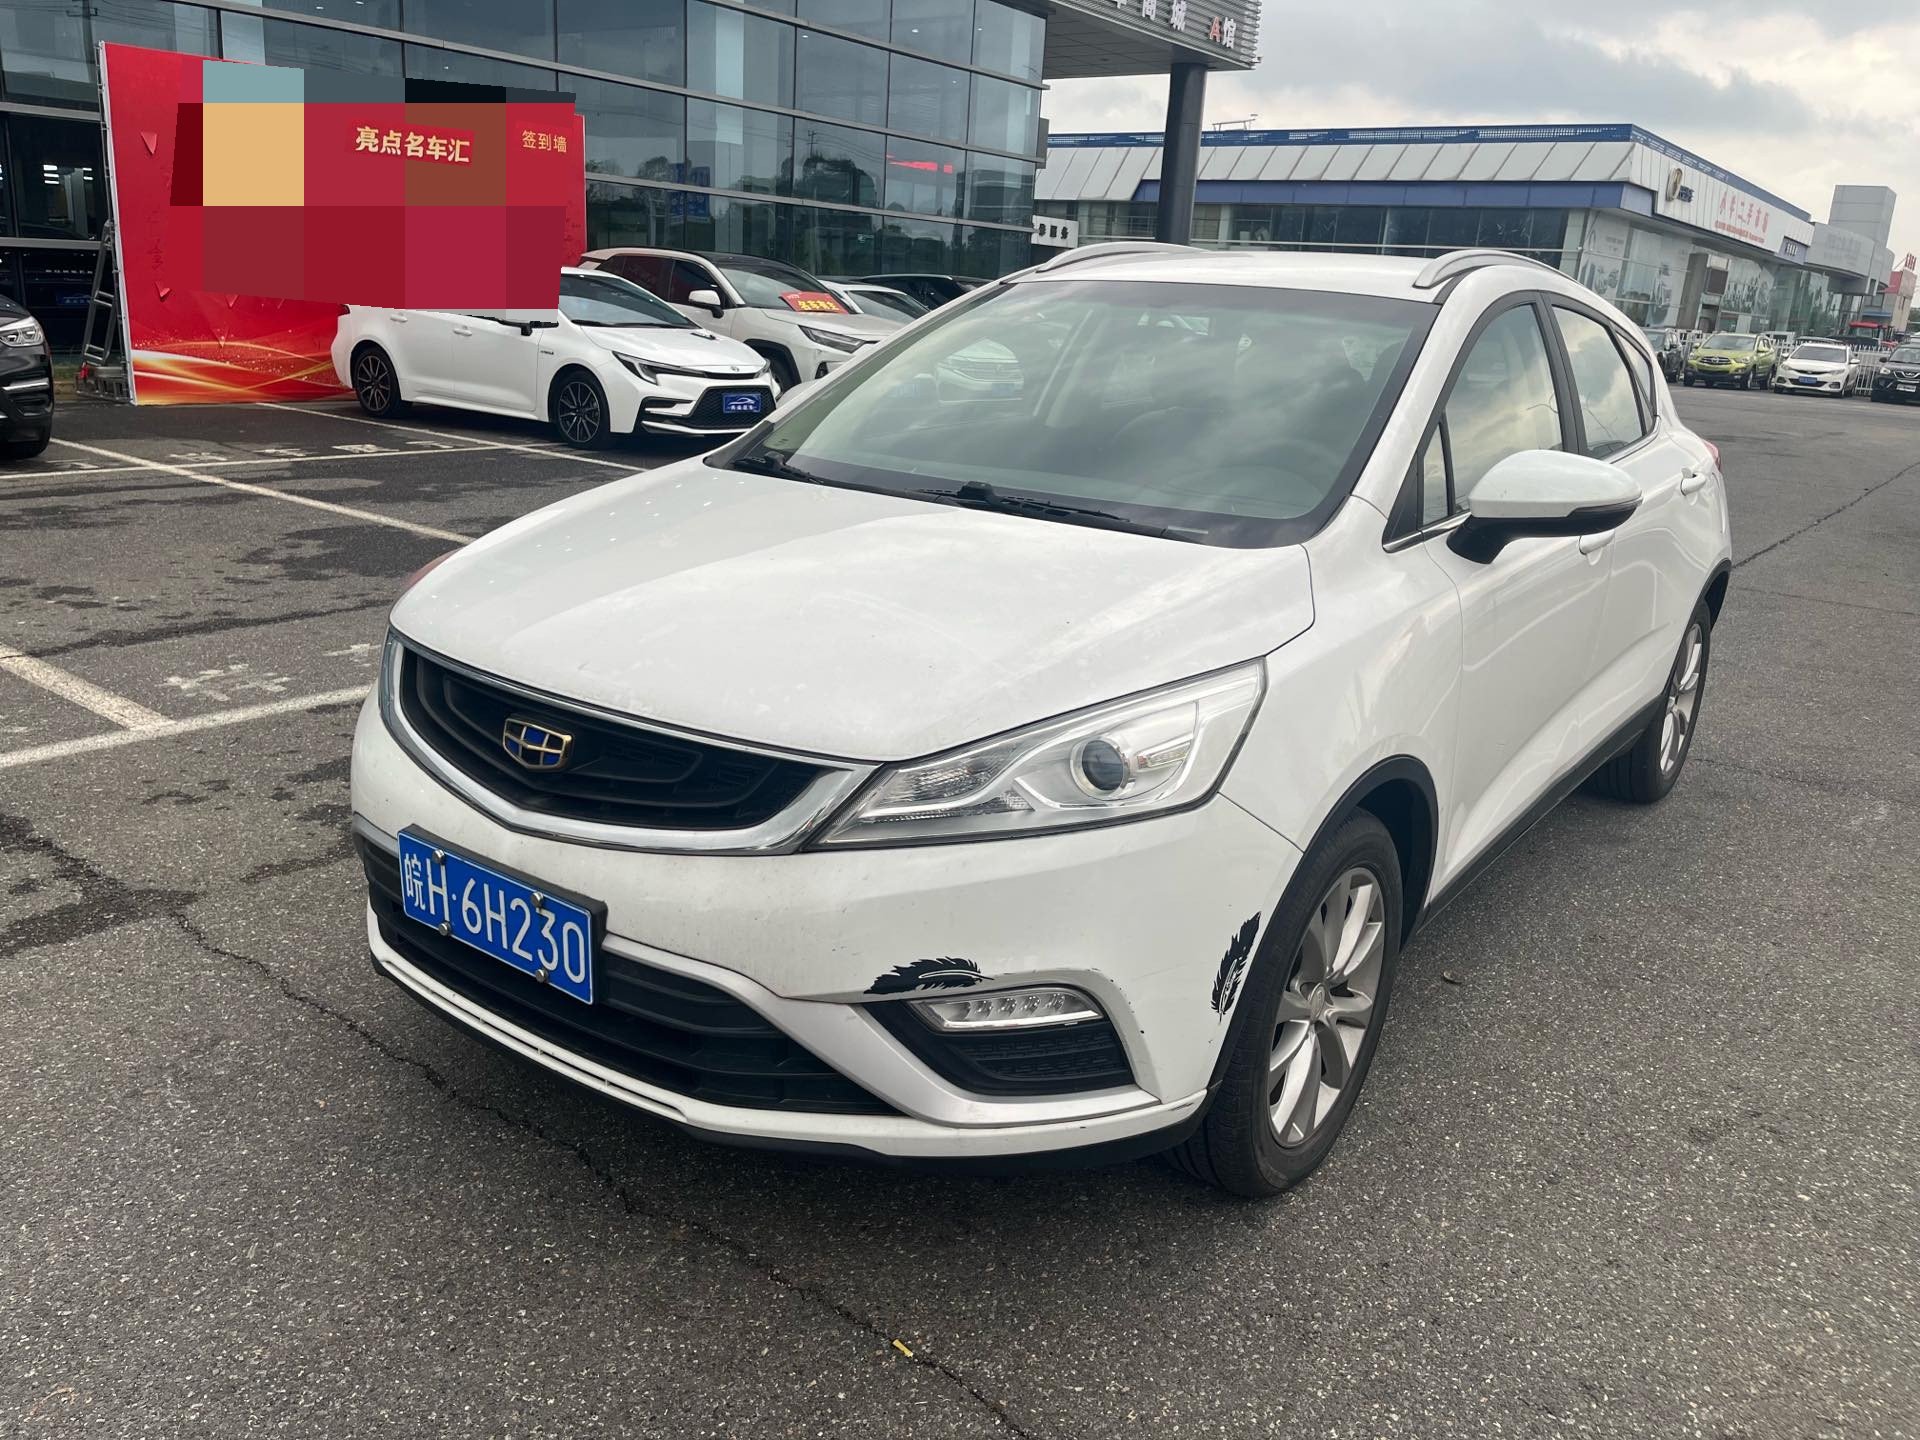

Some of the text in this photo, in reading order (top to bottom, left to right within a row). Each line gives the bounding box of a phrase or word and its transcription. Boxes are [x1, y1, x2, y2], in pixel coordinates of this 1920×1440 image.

[1111, 0, 1187, 31] 商城
[355, 126, 568, 162] 亮点名车汇 签到墙
[404, 853, 585, 984] 皖H·6H230
